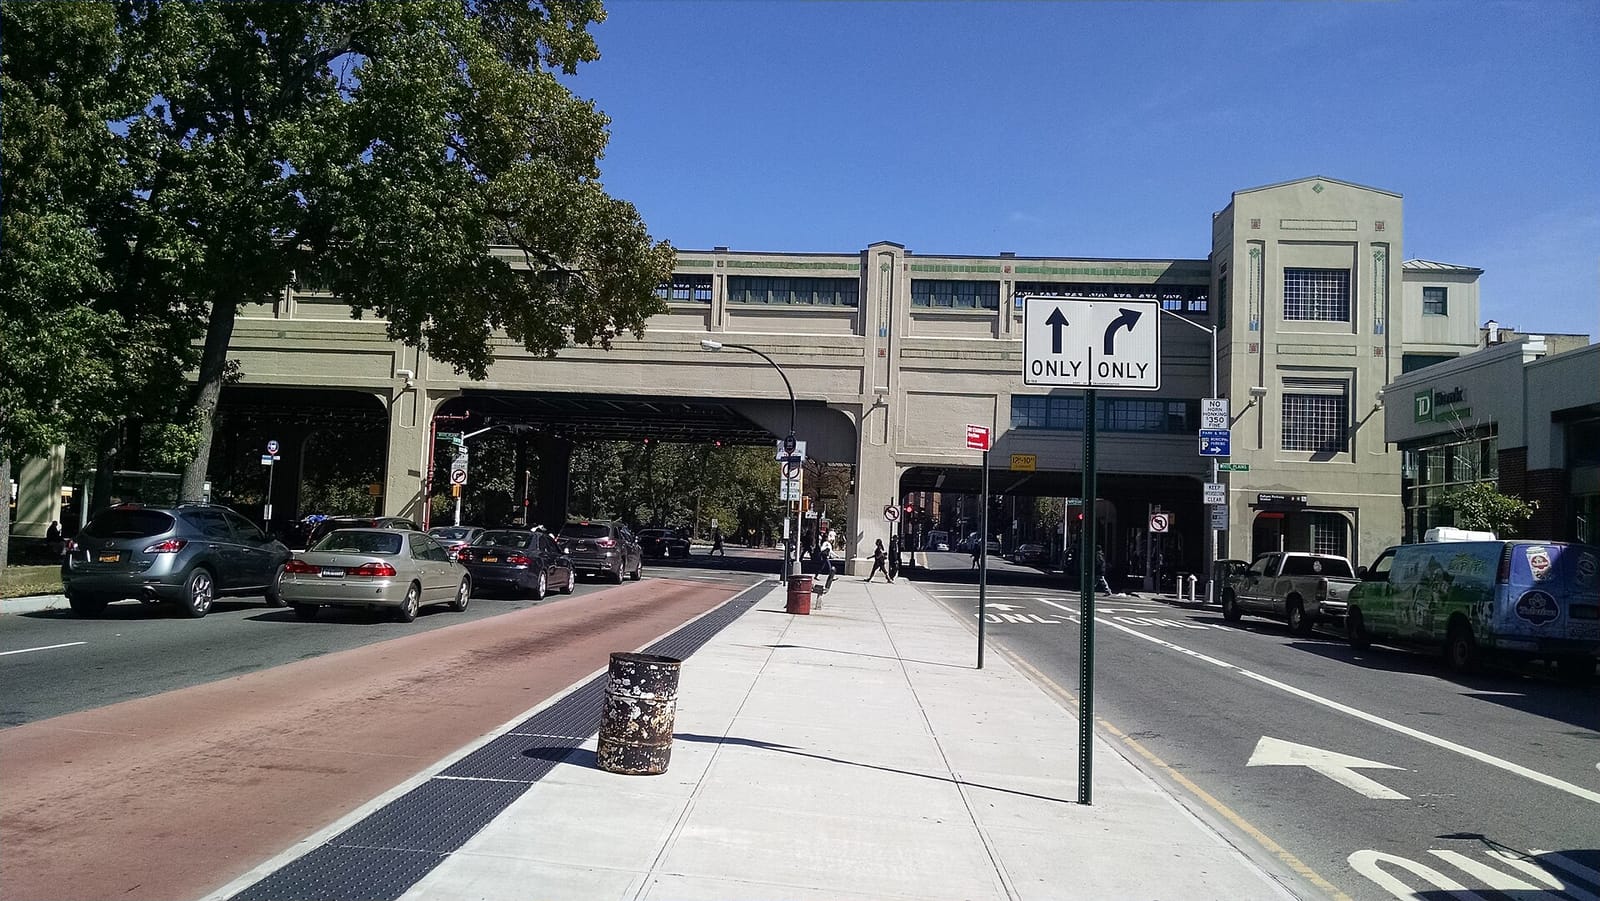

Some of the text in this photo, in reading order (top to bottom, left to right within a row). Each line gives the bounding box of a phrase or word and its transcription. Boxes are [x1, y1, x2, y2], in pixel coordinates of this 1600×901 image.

[1031, 359, 1082, 377] ONLY
[1098, 361, 1148, 379] ONLY
[1209, 400, 1221, 408] NO
[1416, 396, 1430, 416] TD
[1435, 387, 1463, 407] Bank
[1201, 441, 1209, 451] P
